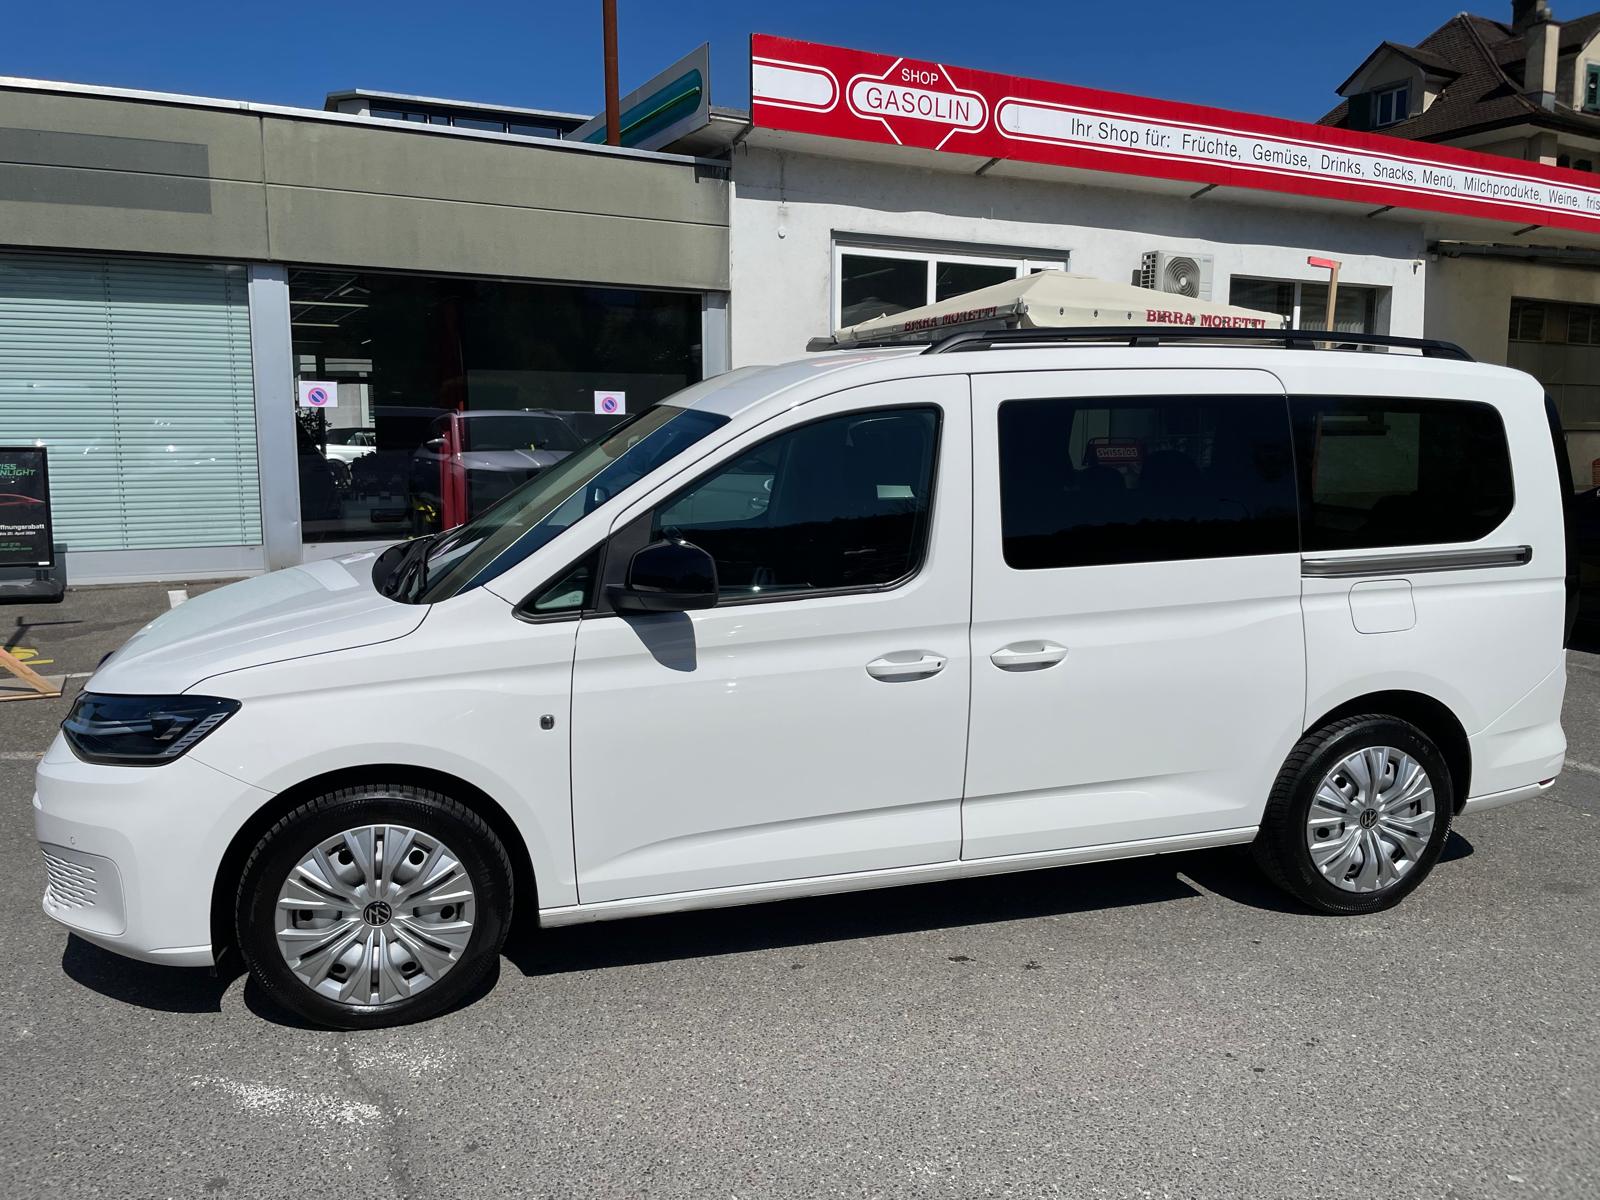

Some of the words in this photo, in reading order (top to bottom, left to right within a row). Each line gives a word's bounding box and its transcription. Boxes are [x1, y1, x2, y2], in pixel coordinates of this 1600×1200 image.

[901, 68, 939, 86] SHOP
[866, 87, 970, 122] GASOLIN
[1071, 117, 1093, 138] Ihr
[1098, 121, 1139, 147] Shop
[1145, 128, 1171, 148] für:
[1182, 133, 1242, 161] Früchte,
[1252, 143, 1311, 170] Gemüse,
[1321, 154, 1366, 178] Drinks,
[1373, 162, 1417, 185] Snacks,
[1464, 176, 1542, 202] Milchprodukte,
[1146, 309, 1196, 326] BIRRA
[1200, 313, 1266, 330] MORETTI
[0, 468, 36, 476] NLIGHT
[0, 523, 45, 531] ffnungsrabatt
